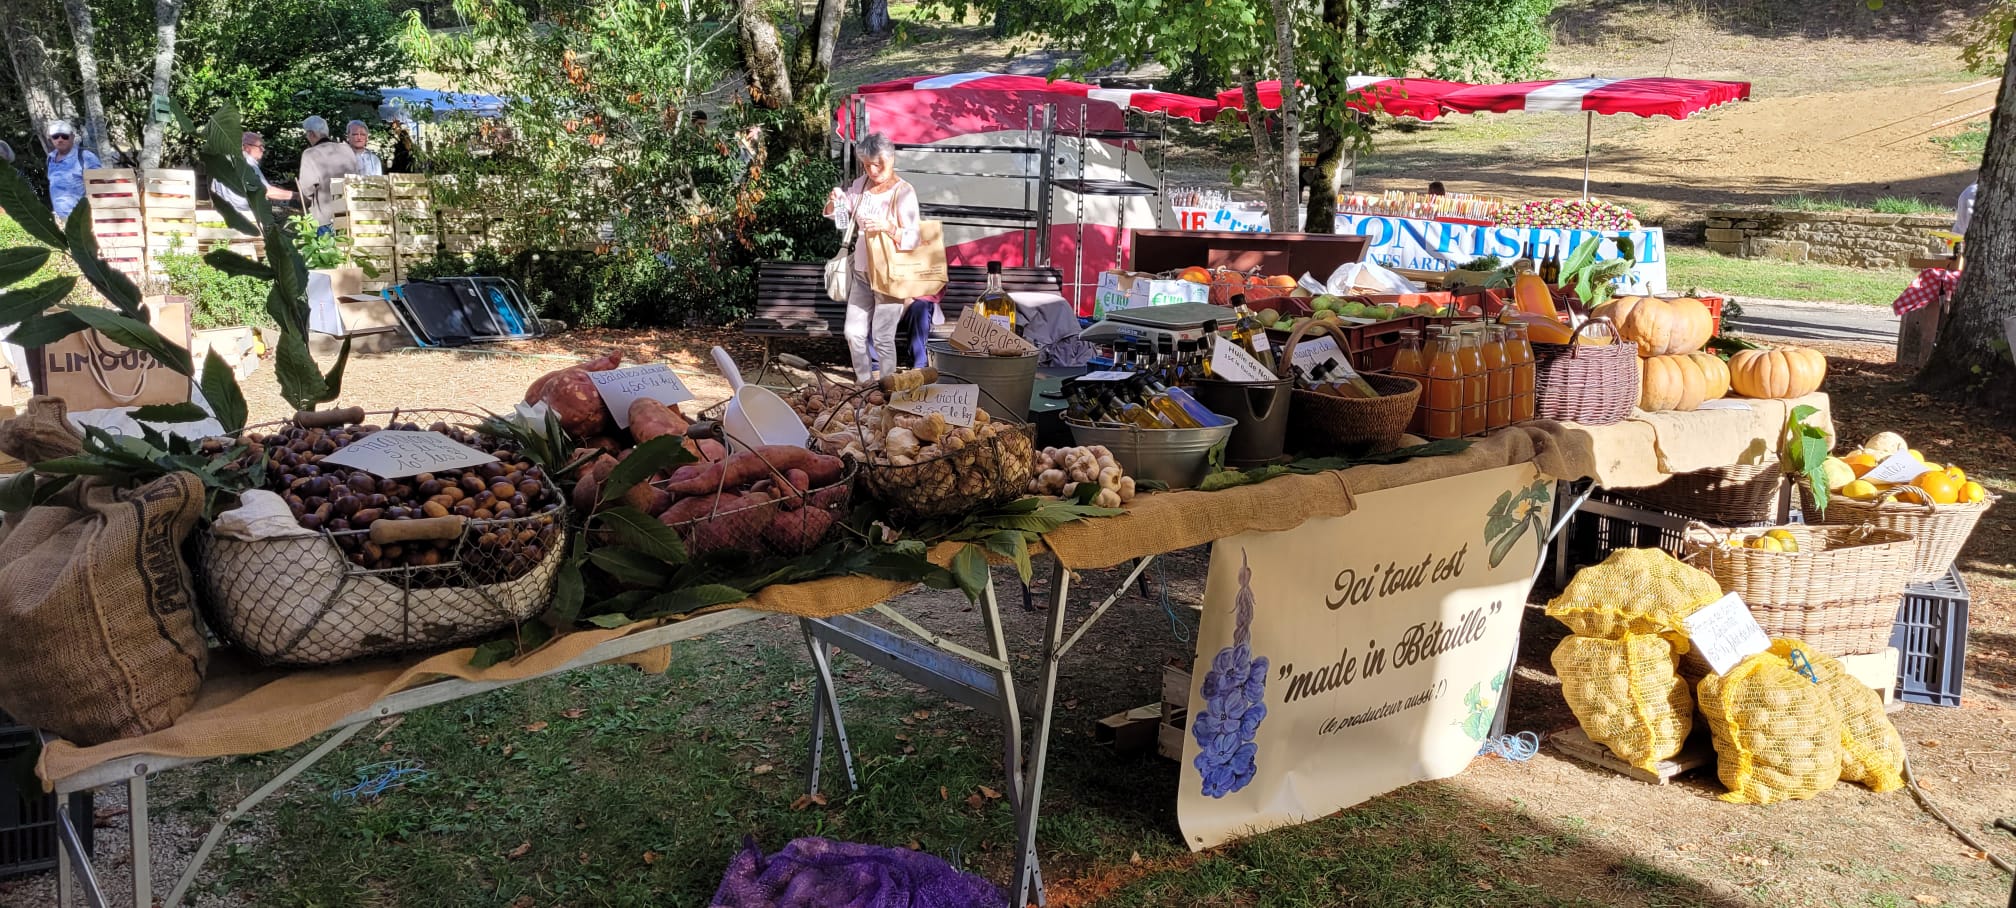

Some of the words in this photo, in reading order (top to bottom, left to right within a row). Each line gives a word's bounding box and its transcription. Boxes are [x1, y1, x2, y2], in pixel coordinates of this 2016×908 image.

[1228, 346, 1248, 363] Huile
[1249, 361, 1257, 371] de
[1258, 368, 1272, 382] Noi
[1325, 563, 1380, 611] Ici
[1379, 552, 1432, 599] tout
[1431, 542, 1468, 585] est
[1362, 639, 1388, 677] in
[1334, 698, 1403, 735] producteur
[1403, 684, 1434, 711] aussi
